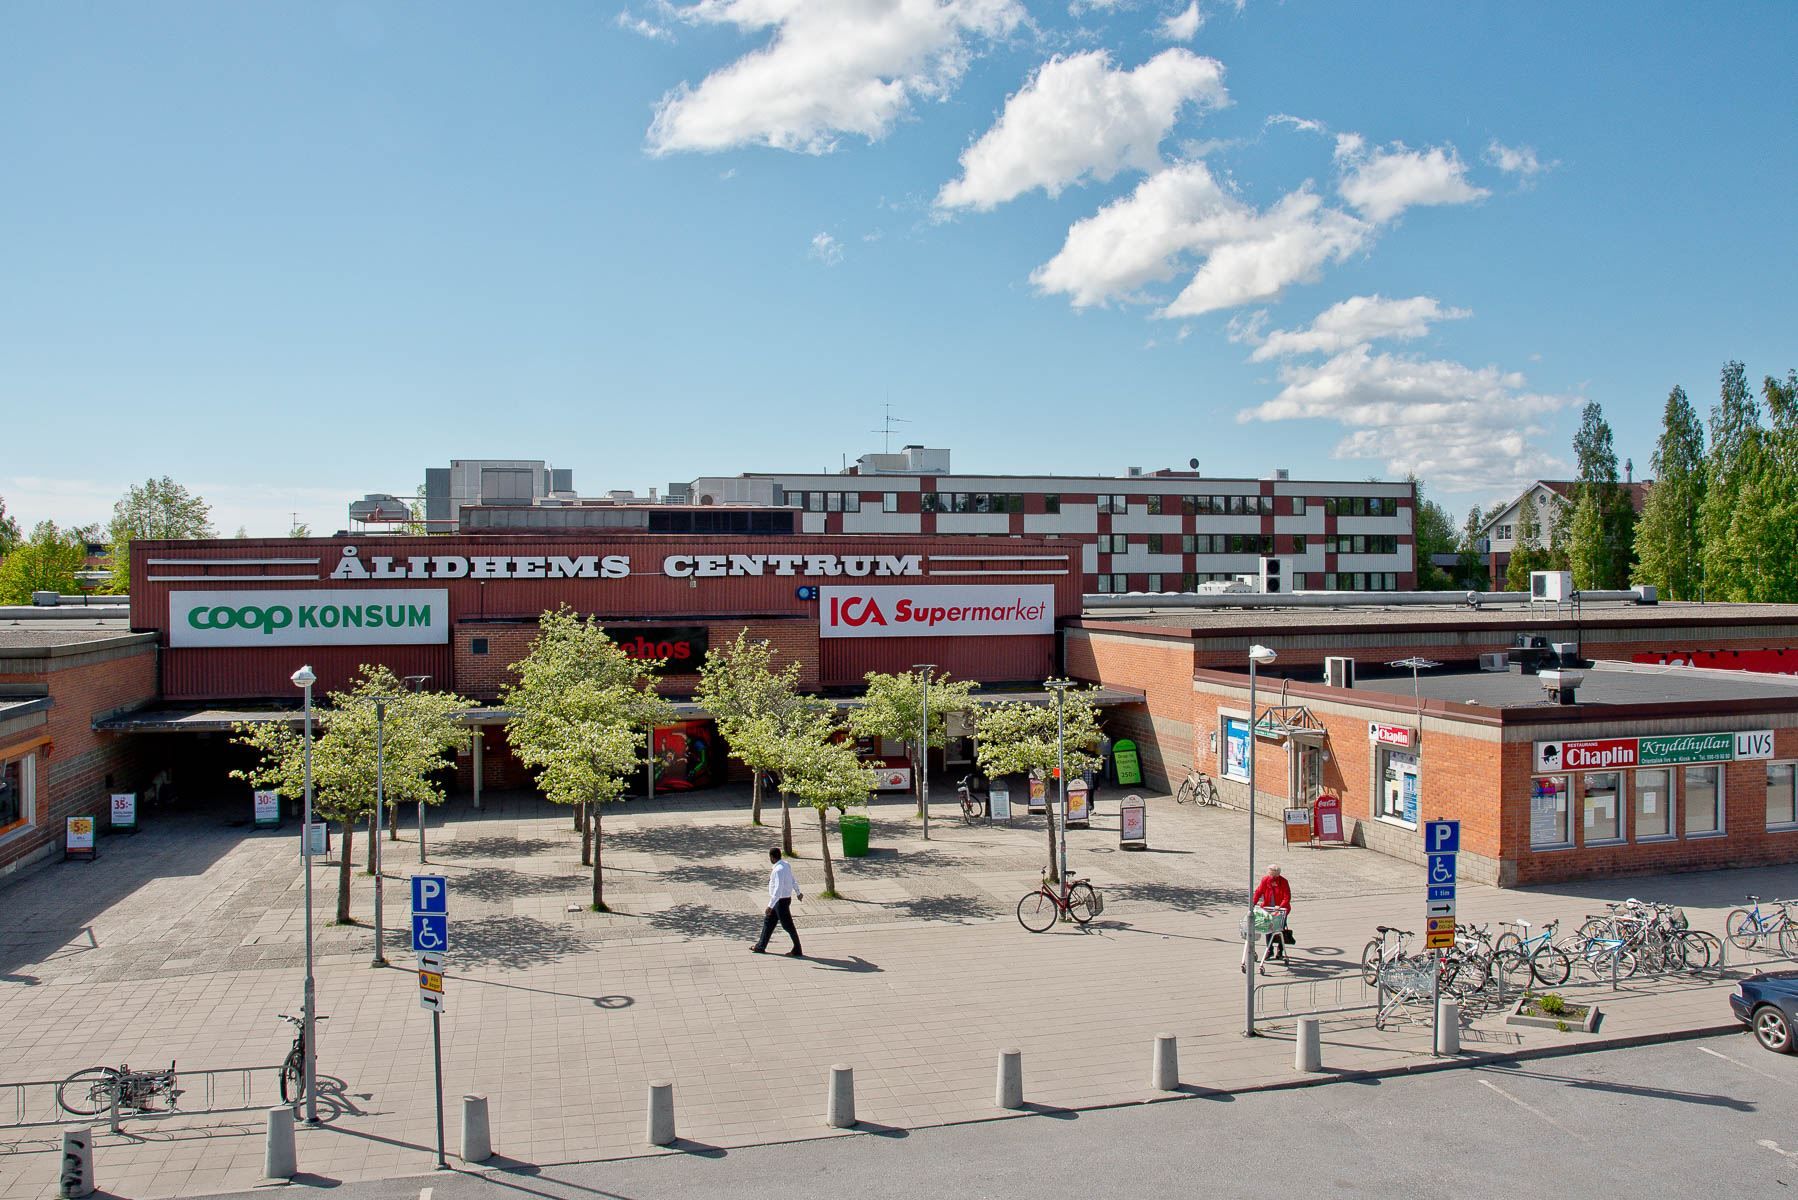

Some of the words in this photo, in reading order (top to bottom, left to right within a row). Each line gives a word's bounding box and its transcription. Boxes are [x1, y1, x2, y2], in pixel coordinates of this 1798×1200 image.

[330, 545, 632, 579] ÅLIDHEMS
[663, 554, 923, 578] CENTRUM
[299, 604, 432, 628] KONSUM
[830, 596, 888, 627] ICA
[894, 598, 1046, 627] Supermarket
[1379, 728, 1408, 745] Chaplin
[1642, 736, 1731, 756] Kryddhyllan
[1737, 734, 1772, 755] LIVS
[1566, 746, 1634, 767] Chaplin
[114, 799, 133, 810] 35:-
[257, 795, 276, 805] 30:-
[74, 821, 88, 832] 5:-
[1435, 824, 1451, 850] P
[420, 879, 441, 910] P
